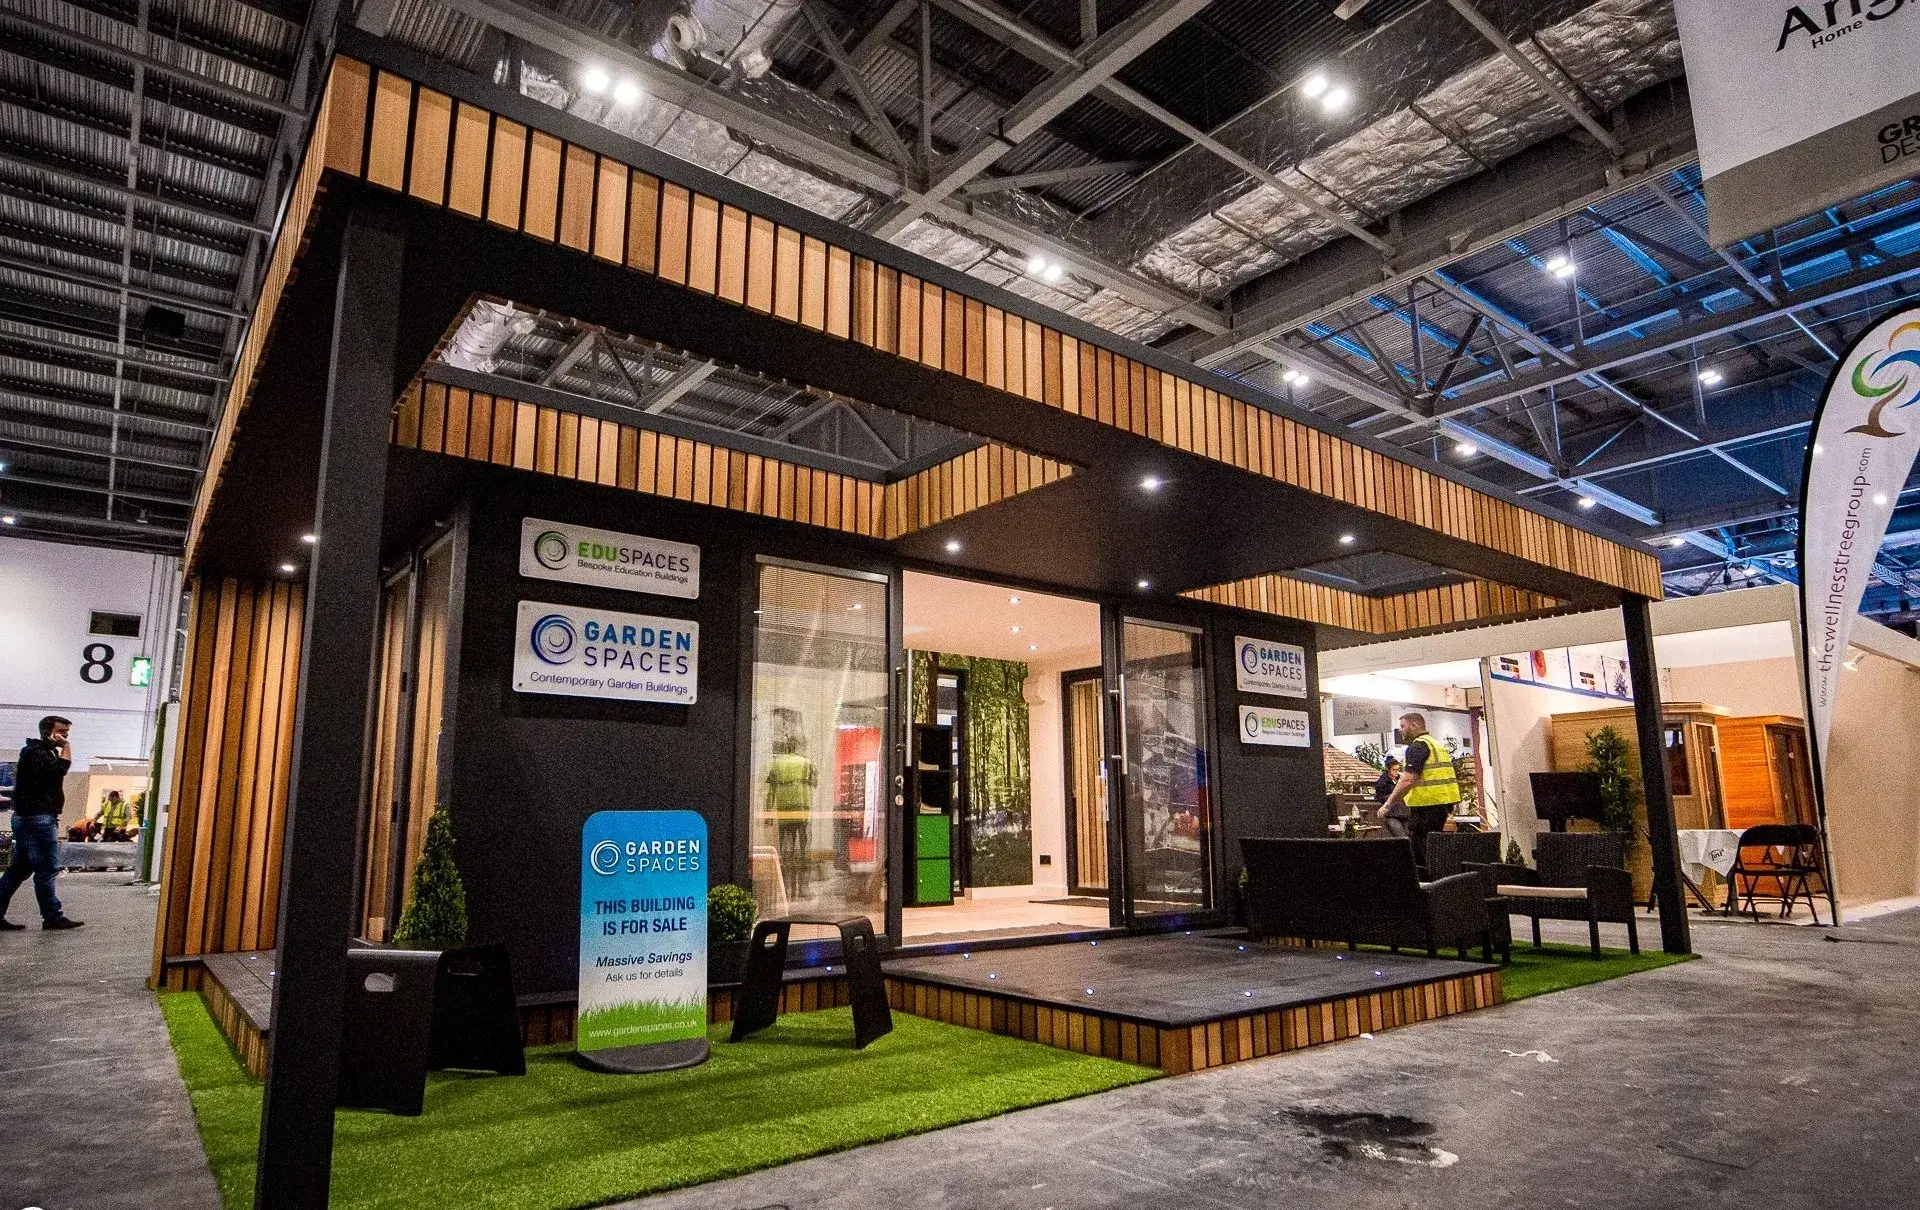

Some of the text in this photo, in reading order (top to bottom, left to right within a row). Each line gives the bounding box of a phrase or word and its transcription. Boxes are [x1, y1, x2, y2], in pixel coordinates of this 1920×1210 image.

[1811, 20, 1863, 49] Home
[1880, 136, 1920, 164] DE
[577, 541, 690, 573] EDUSPACES
[577, 559, 689, 584] Bespoke Education Buildings
[584, 621, 691, 652] GARDEN
[80, 643, 115, 684] 8
[583, 646, 688, 675] SPACES
[1260, 647, 1302, 665] GARDEN
[1261, 662, 1302, 680] SPACES
[530, 671, 688, 695] Contemporary Garden Buildings
[1261, 716, 1306, 731] EDUSPACES
[625, 839, 700, 856] GARDEN
[626, 856, 700, 873] SPACES
[595, 896, 695, 915] THIS BUILDING
[603, 917, 687, 936] IS FOR SALE
[596, 952, 693, 968] Massive Savings
[605, 967, 684, 983] Ask us for details
[588, 1019, 698, 1038] www.gardenspaces.co.uk
